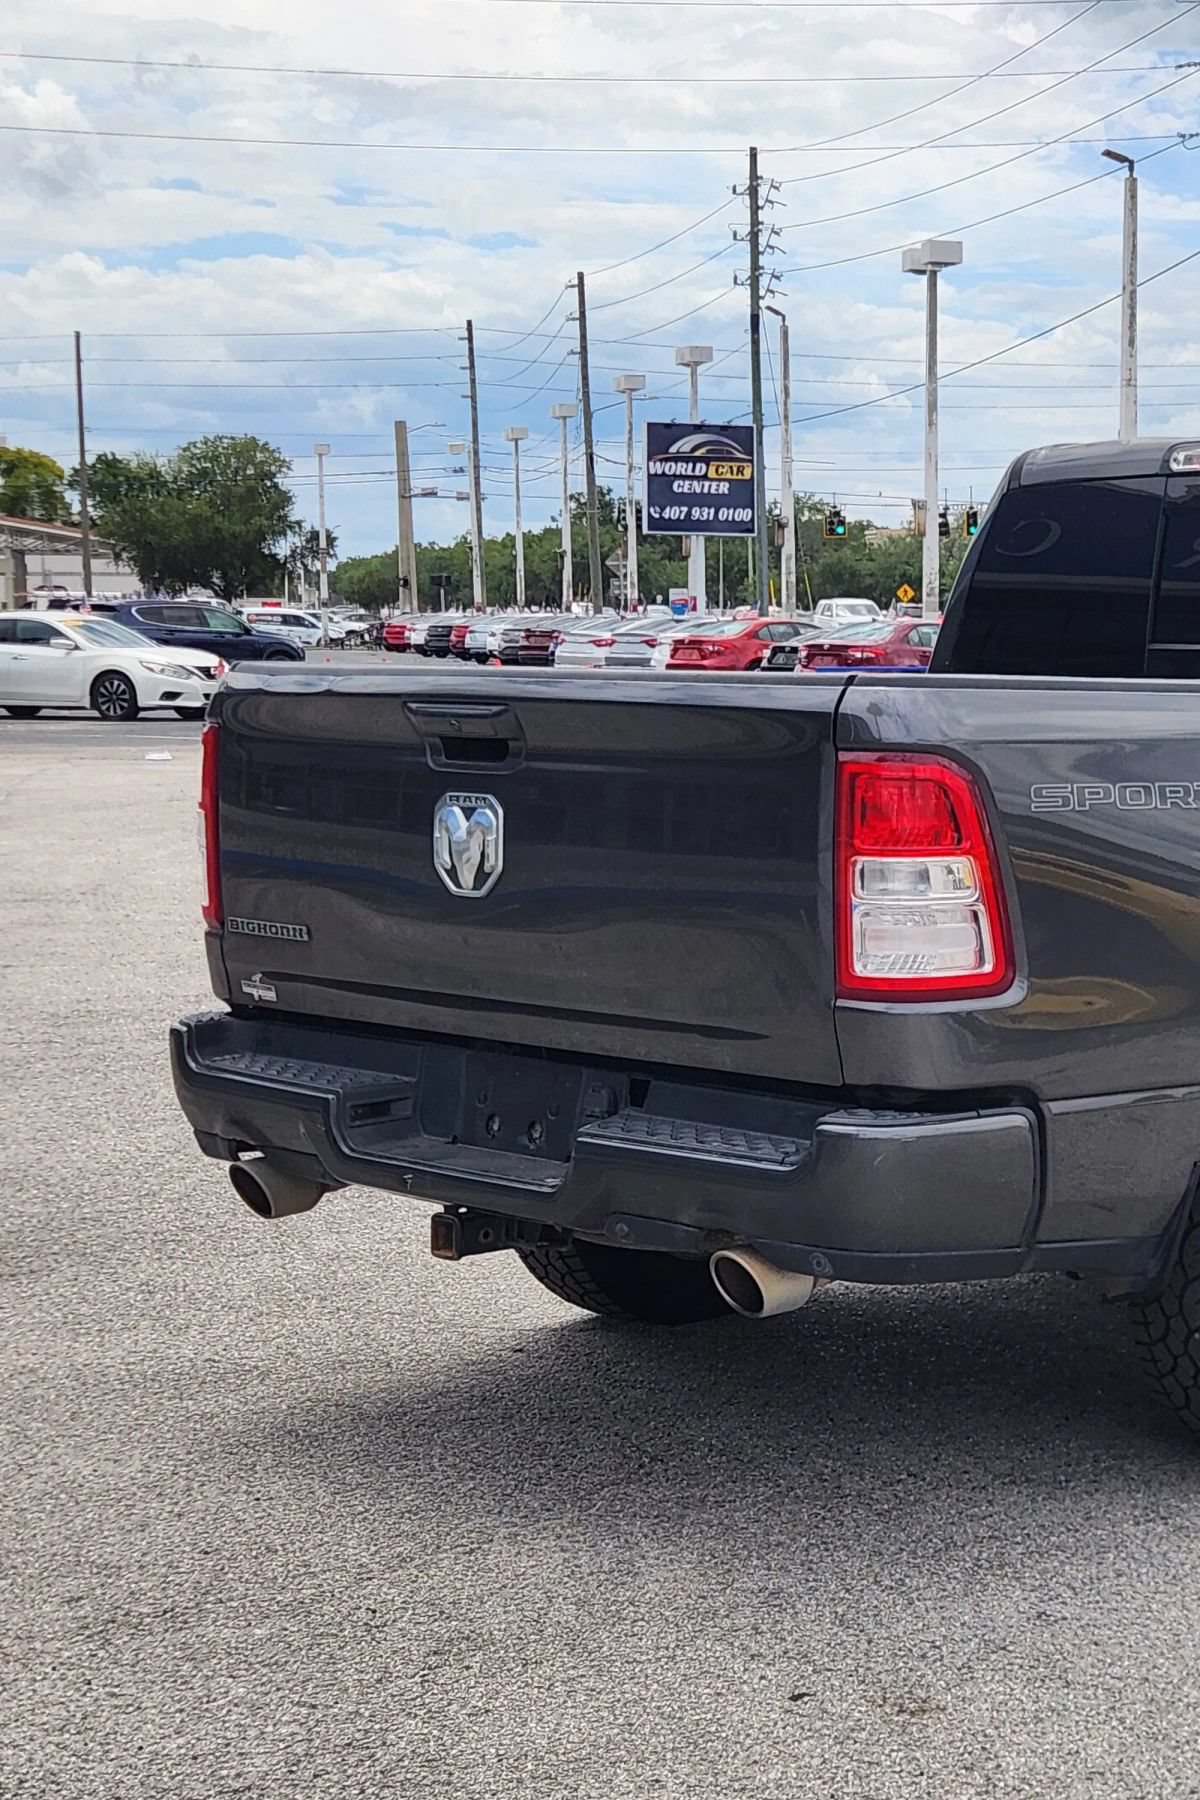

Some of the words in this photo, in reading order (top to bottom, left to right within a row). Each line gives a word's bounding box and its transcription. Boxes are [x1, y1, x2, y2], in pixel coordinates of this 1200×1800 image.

[648, 461, 707, 476] WORLD
[714, 464, 746, 477] CAR
[672, 480, 730, 494] CENTER
[662, 506, 688, 520] 407
[691, 507, 715, 521] 931
[718, 507, 752, 522] 0100
[448, 795, 488, 805] RAM
[228, 917, 308, 940] BIGHORN
